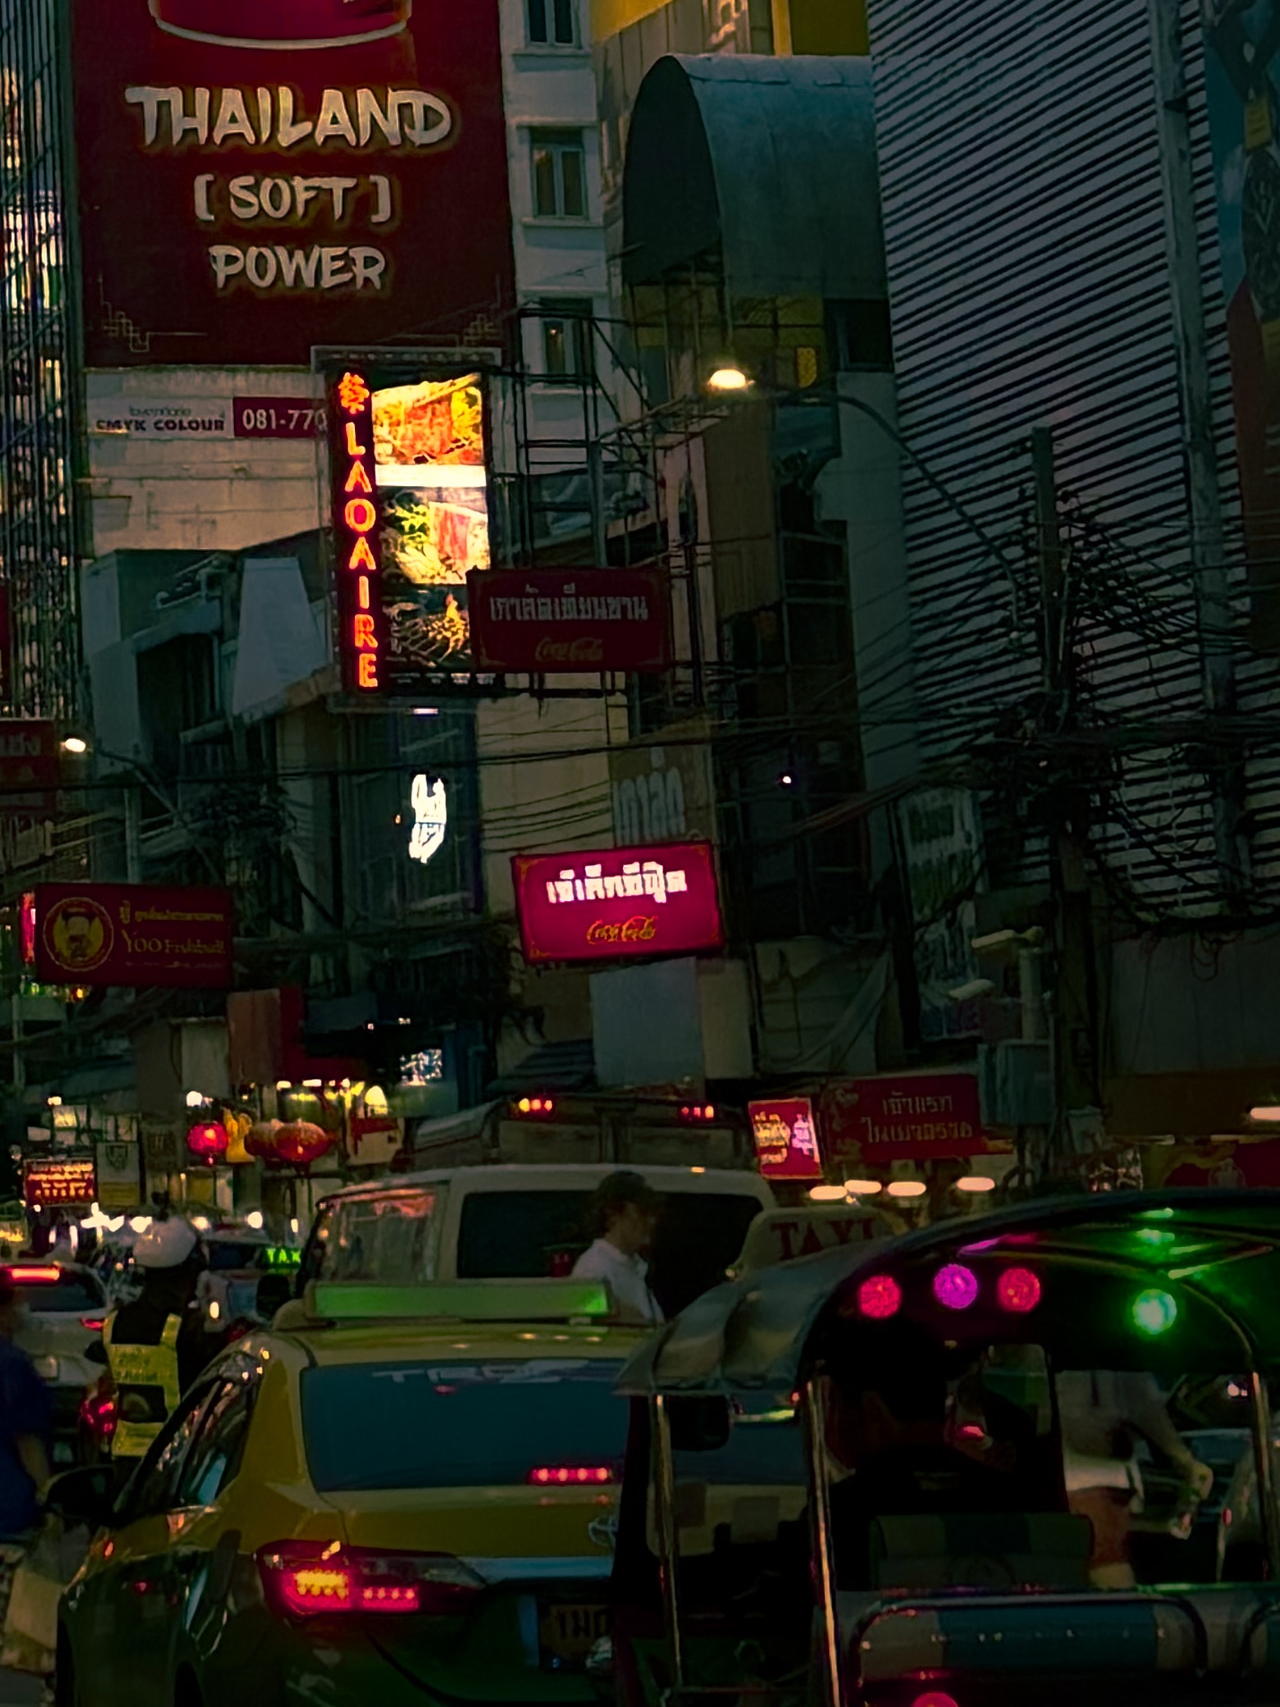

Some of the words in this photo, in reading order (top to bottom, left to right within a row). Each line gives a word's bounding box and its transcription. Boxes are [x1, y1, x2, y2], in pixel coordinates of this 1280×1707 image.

[124, 85, 452, 148] THAILAND
[208, 245, 386, 290] POWER
[153, 418, 225, 432] COLOUR
